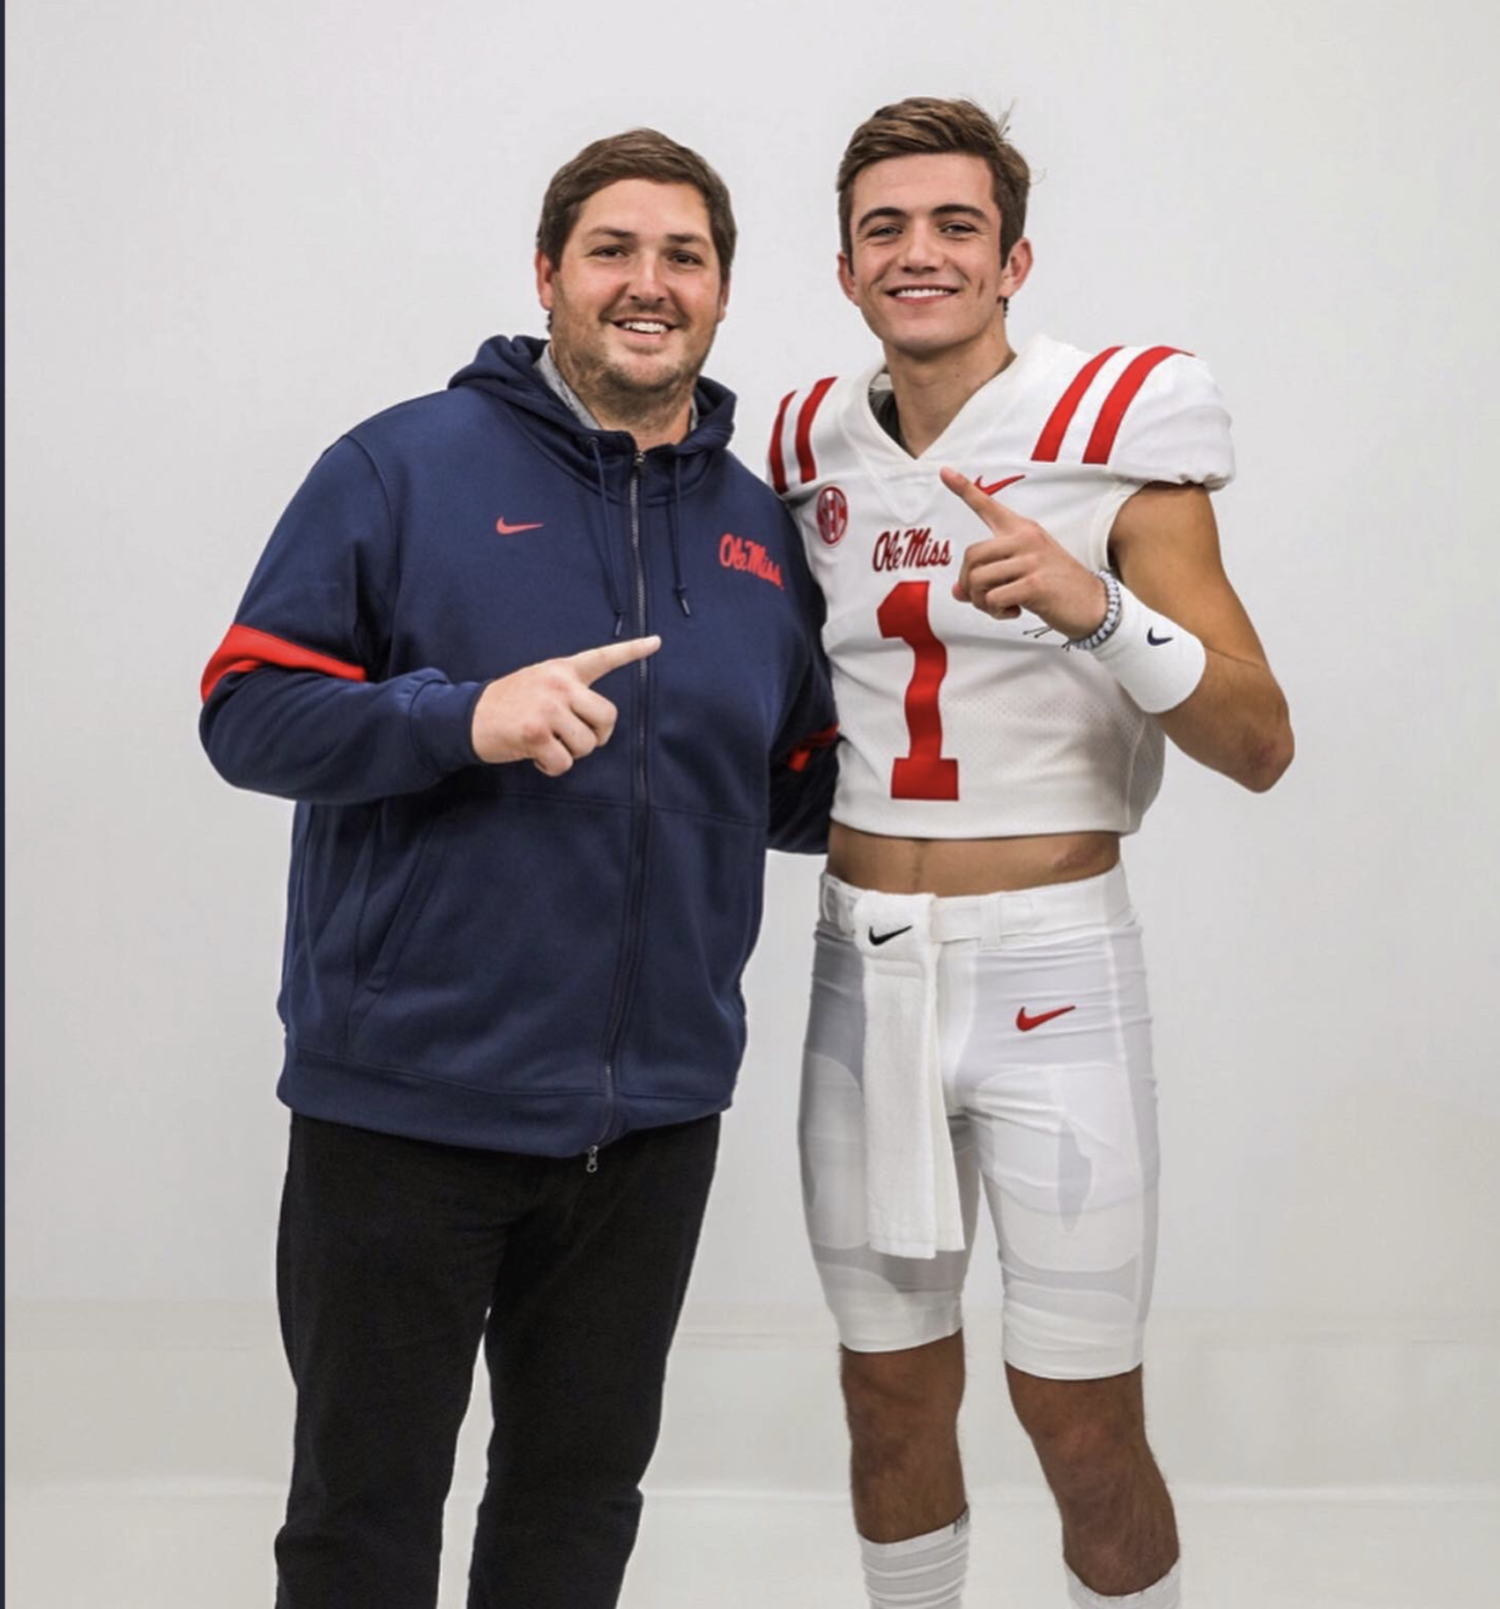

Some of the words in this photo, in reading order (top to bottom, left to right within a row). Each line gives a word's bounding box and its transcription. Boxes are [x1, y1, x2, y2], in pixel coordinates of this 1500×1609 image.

[719, 533, 746, 570] Ole
[743, 540, 783, 590] Miss
[873, 530, 903, 572] Ole
[902, 527, 952, 568] Miss
[877, 580, 960, 801] 1
